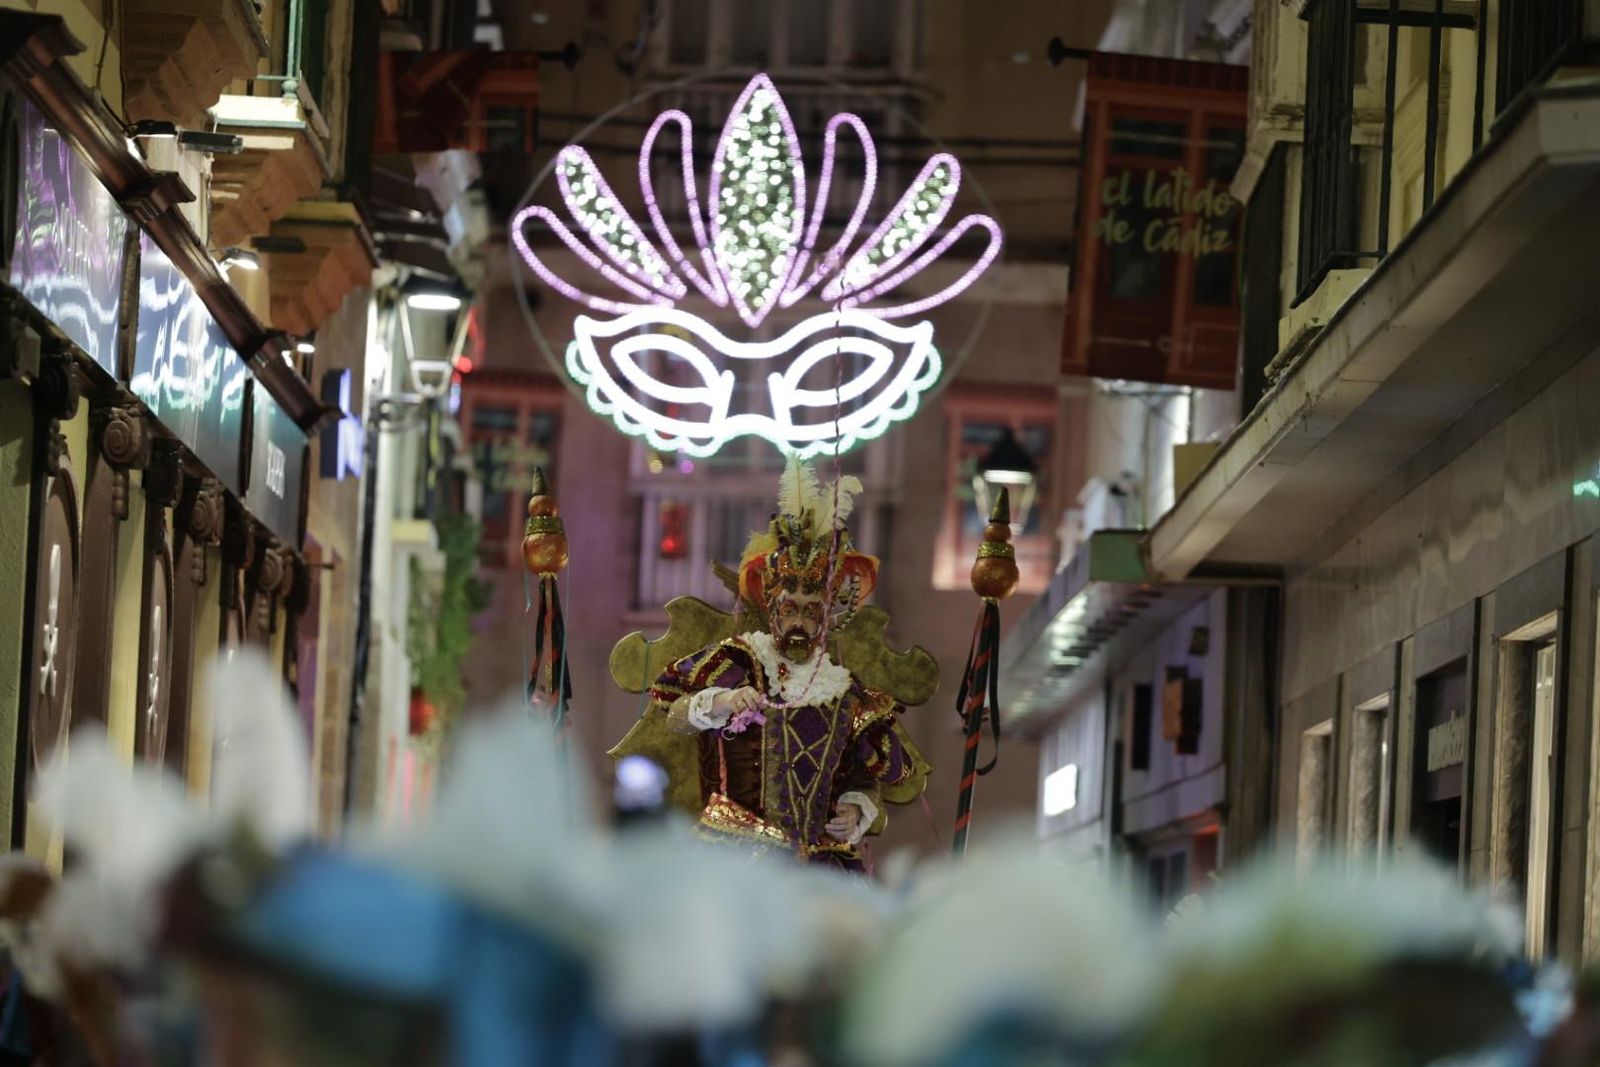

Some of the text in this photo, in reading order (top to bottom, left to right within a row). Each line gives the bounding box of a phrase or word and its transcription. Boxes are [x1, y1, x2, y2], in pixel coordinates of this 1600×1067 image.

[1143, 166, 1234, 218] latido
[1092, 209, 1233, 259] de Cádiz
